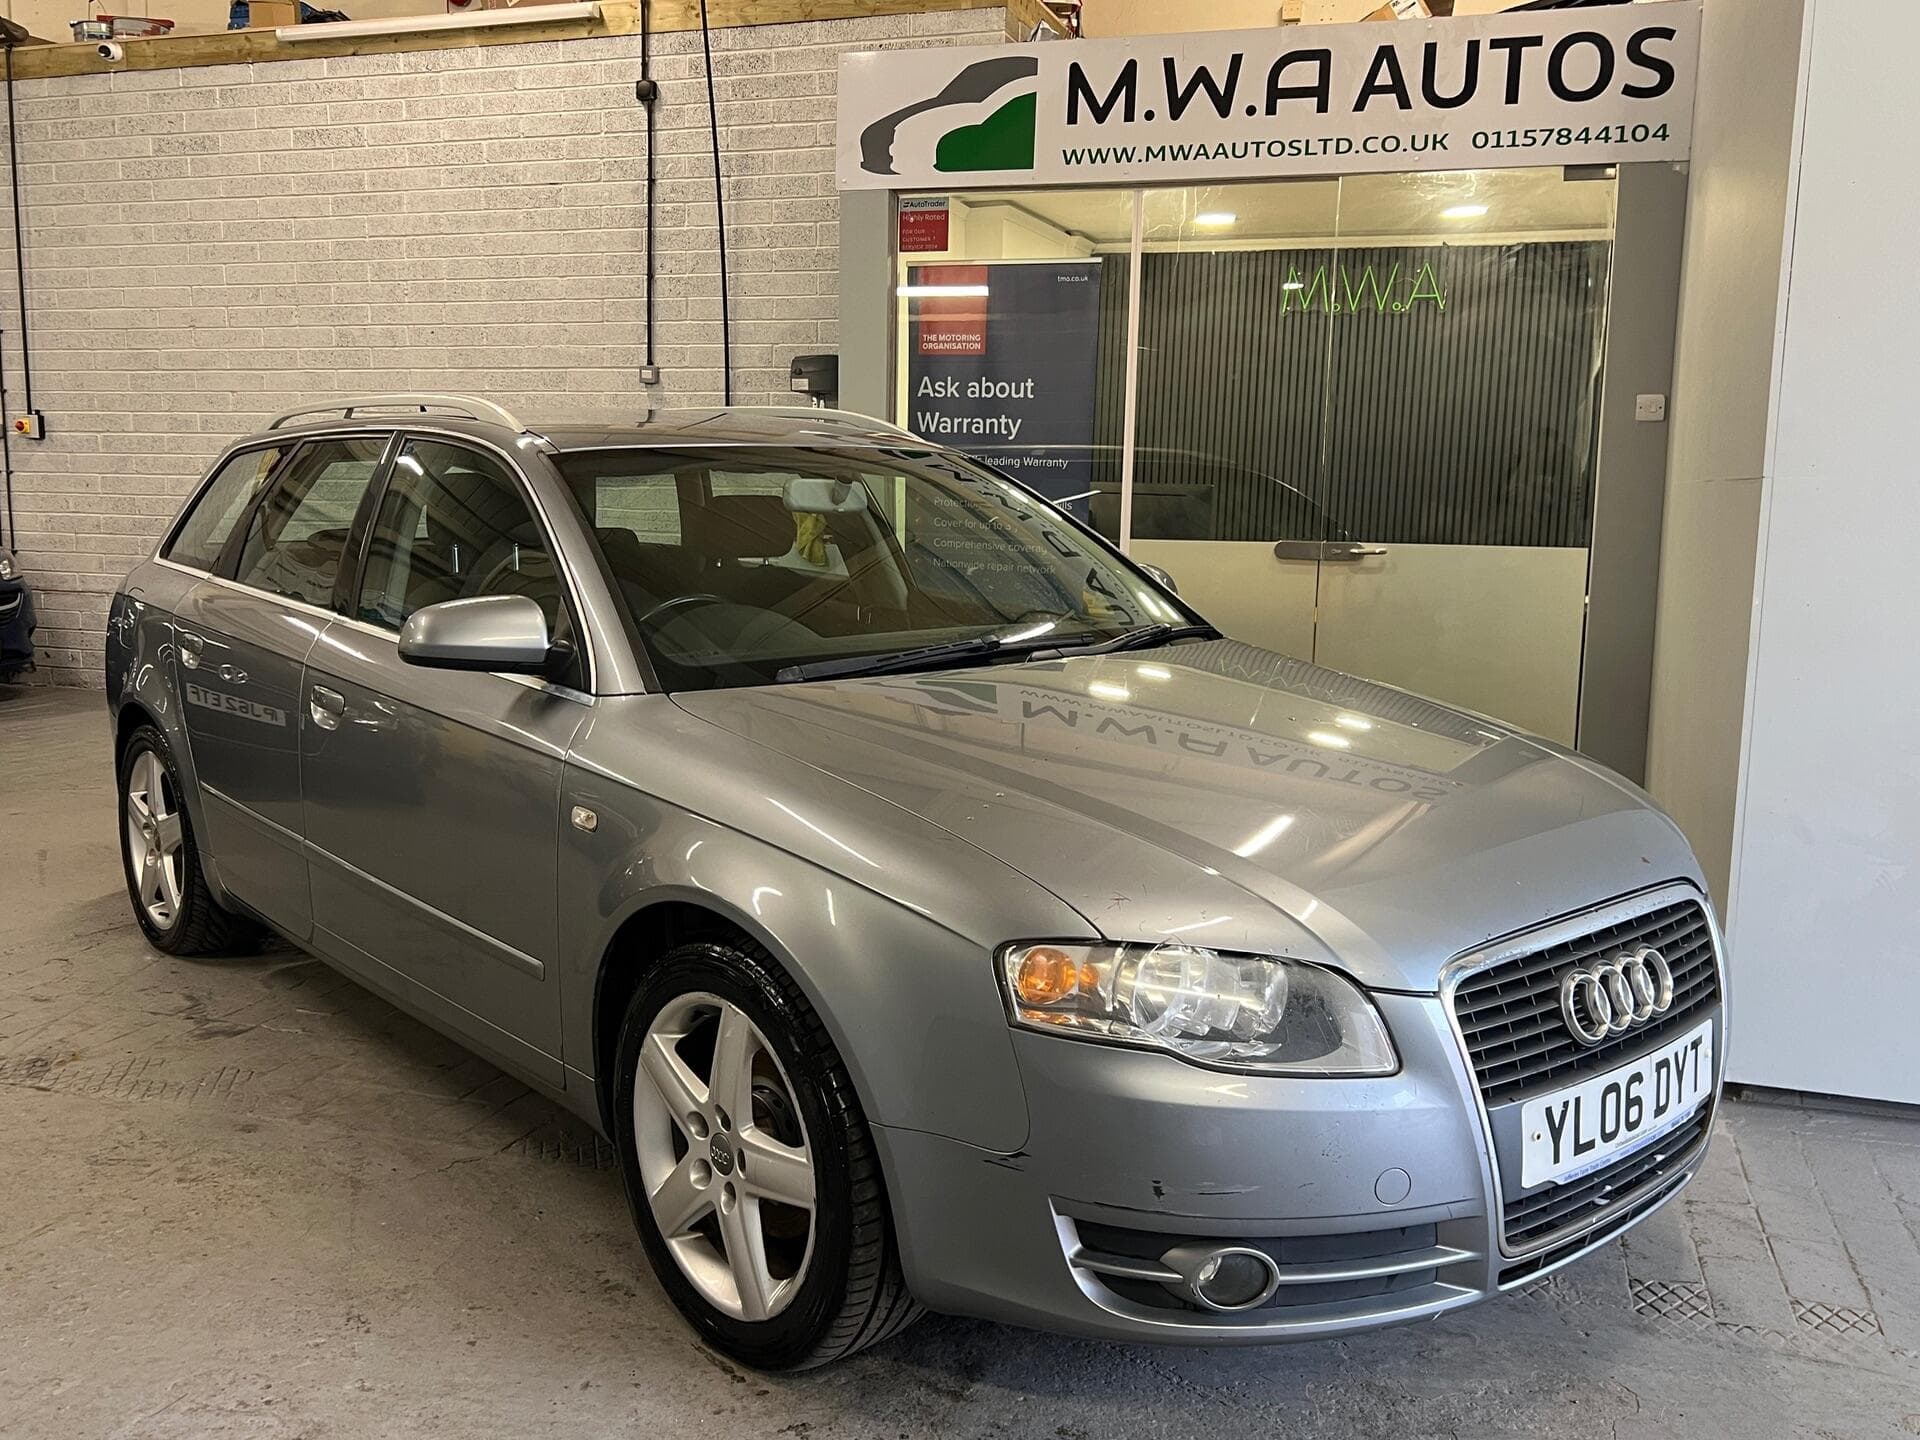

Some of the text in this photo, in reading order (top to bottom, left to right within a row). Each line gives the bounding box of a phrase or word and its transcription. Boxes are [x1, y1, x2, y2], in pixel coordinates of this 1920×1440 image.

[1066, 26, 1677, 125] M.W.A AUTOS
[1062, 123, 1670, 166] WWW.MWAAUTOSLTD.CO.UK 01157844104
[909, 200, 946, 208] AutoTrader
[924, 213, 945, 221] Rated
[1057, 274, 1089, 282] tmo.co.uk
[922, 334, 981, 342] THE MOTORING
[922, 342, 981, 350] ORGANISATION
[917, 376, 1034, 399] Ask about
[917, 411, 1022, 440] Warranty
[985, 455, 1020, 469] leading
[1023, 456, 1069, 470] Warranty
[933, 517, 963, 529] Cover
[964, 518, 977, 529] for
[979, 520, 991, 531] up
[933, 537, 1007, 552] Comprehensive
[933, 558, 1056, 575] Nationwide repair network
[1545, 1034, 1703, 1165] YL06 DYT
